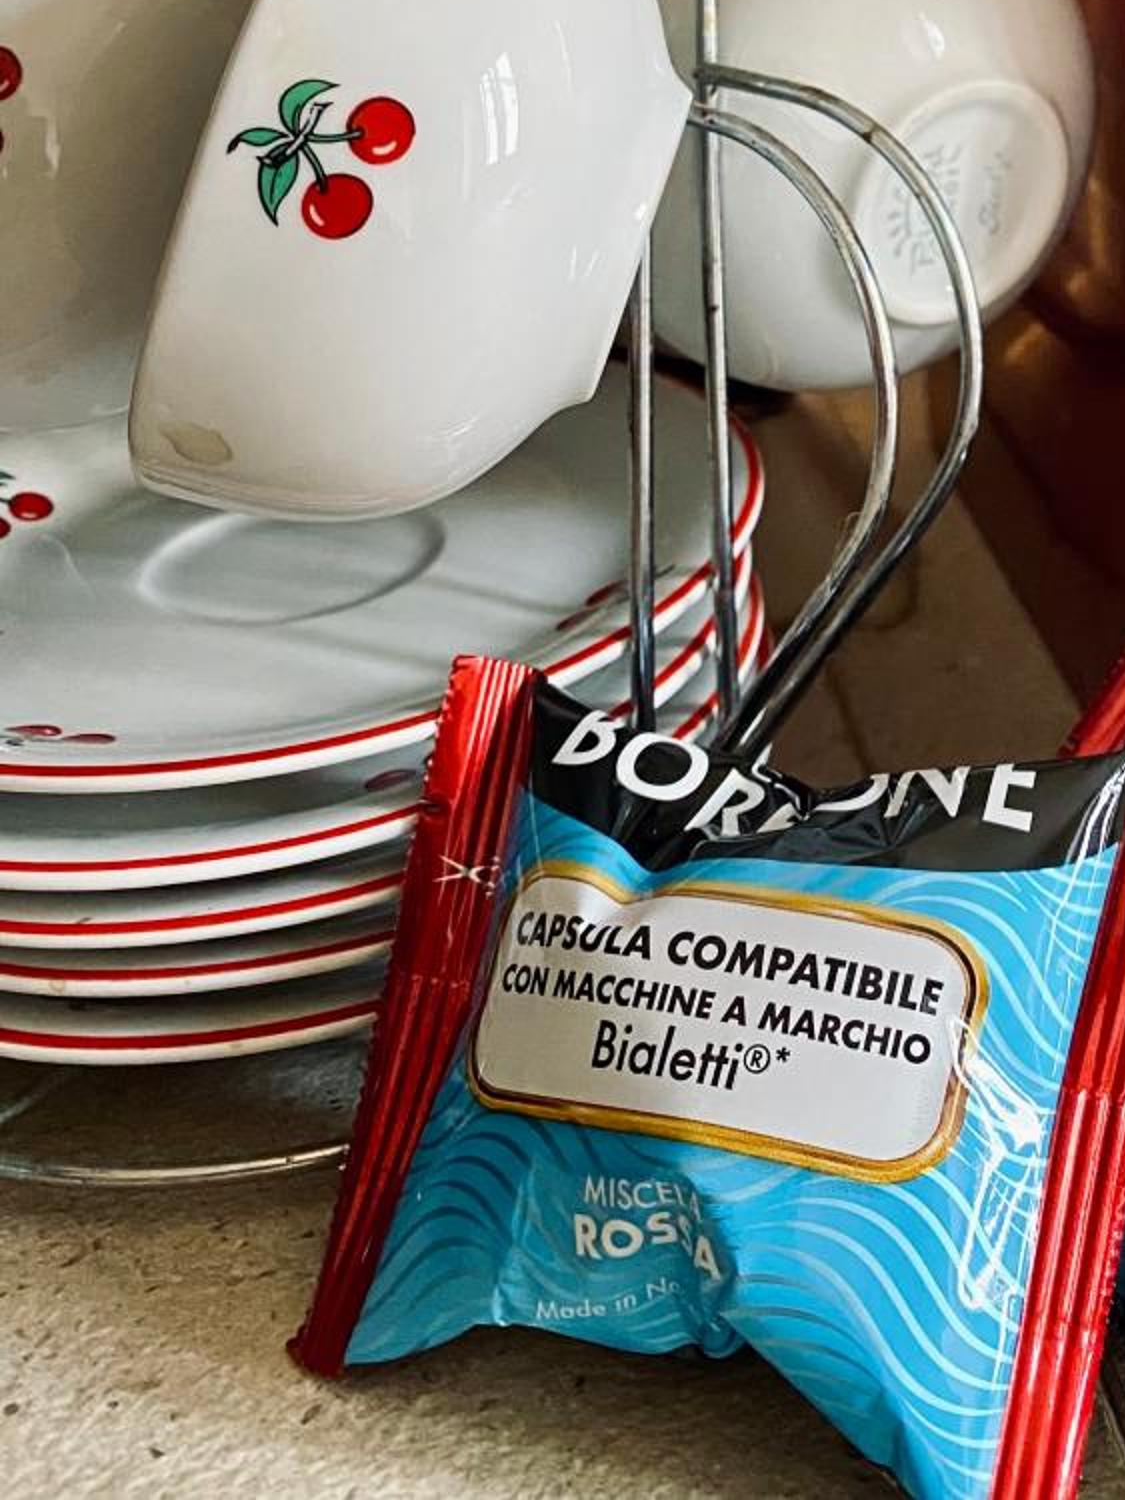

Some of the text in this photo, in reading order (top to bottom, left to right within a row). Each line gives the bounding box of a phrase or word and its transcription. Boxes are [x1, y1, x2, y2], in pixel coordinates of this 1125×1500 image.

[516, 911, 944, 1017] CAPSULA COMPATIBILE
[502, 963, 932, 1065] CON MACCHINE A MARCHIO
[573, 1211, 722, 1282] ROSSA
[536, 1293, 637, 1321] Made in
